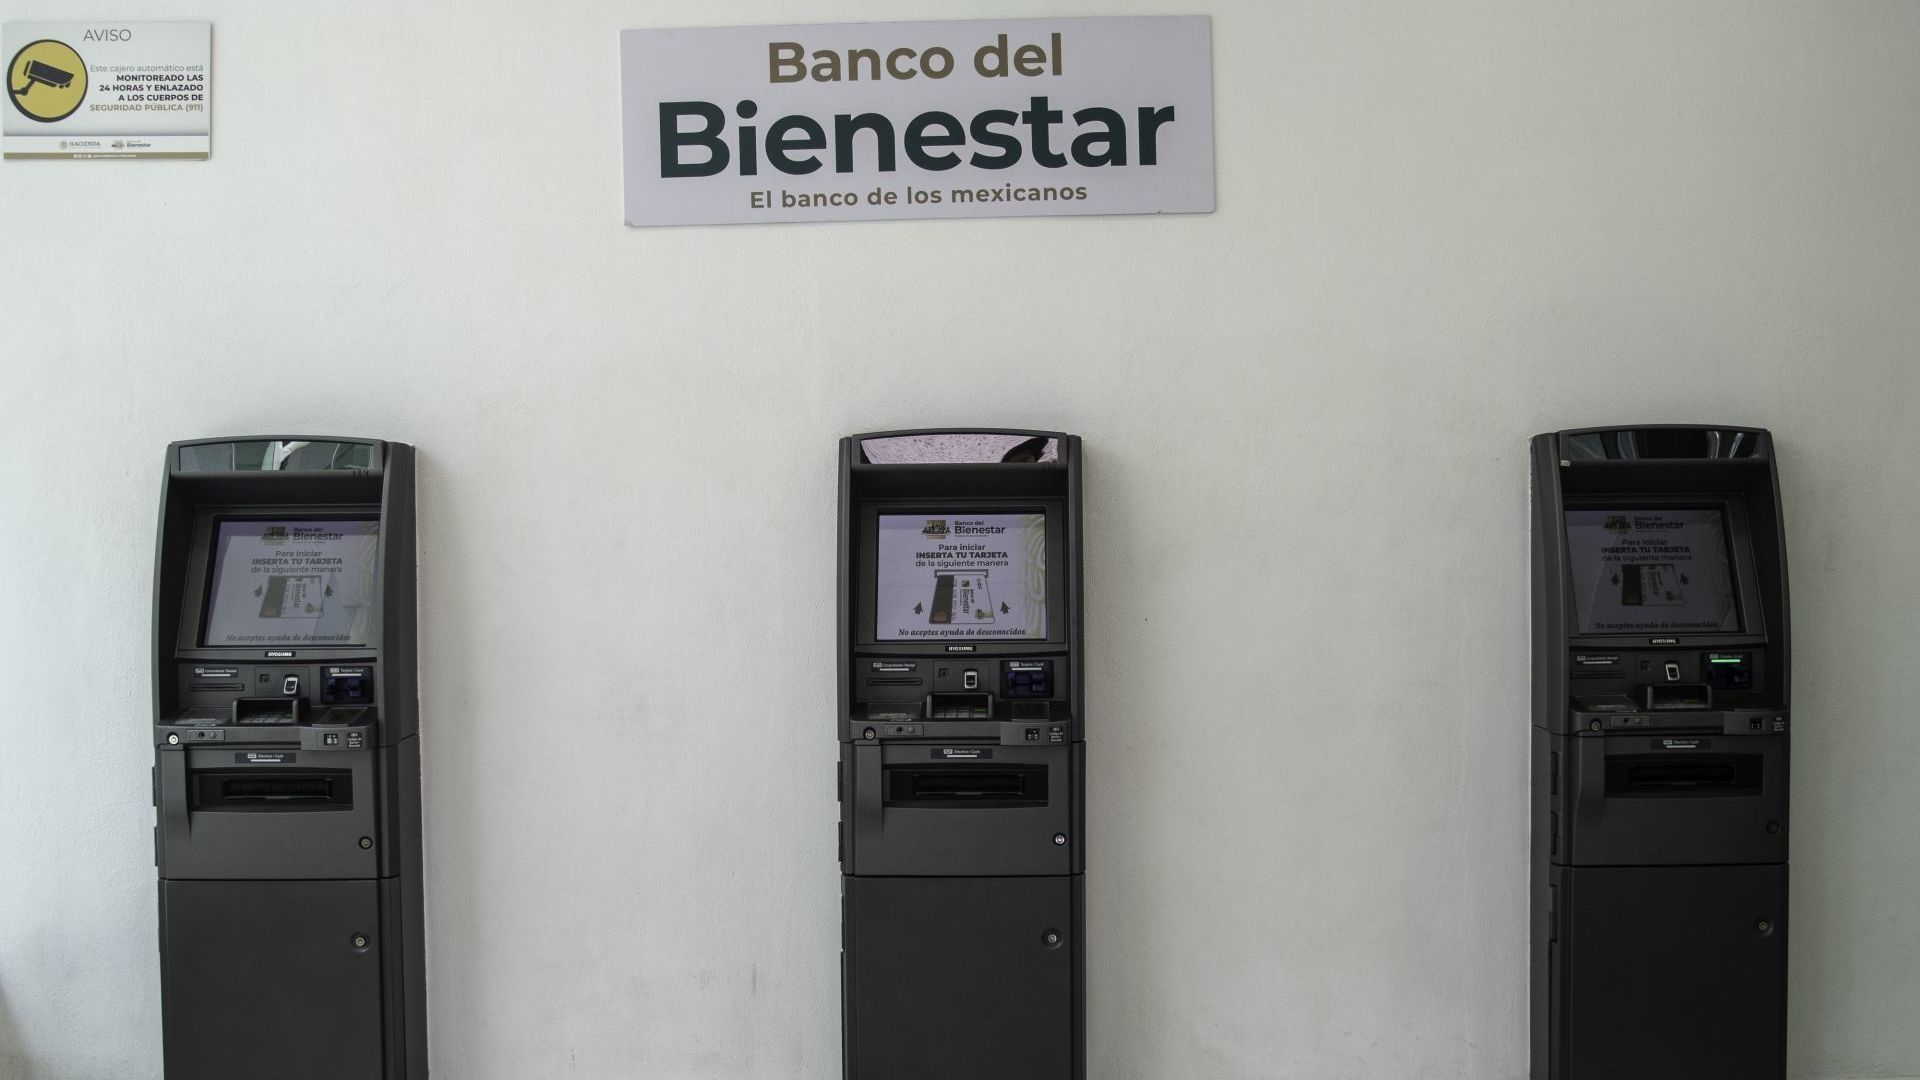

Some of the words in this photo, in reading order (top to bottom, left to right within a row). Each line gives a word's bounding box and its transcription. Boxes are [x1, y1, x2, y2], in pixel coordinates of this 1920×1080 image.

[83, 29, 132, 42] AVISO
[769, 41, 955, 83] Banco
[973, 33, 1063, 78] del
[90, 65, 108, 73] Este
[110, 65, 135, 74] cajero
[136, 64, 185, 73] automático
[186, 64, 204, 72] está
[116, 74, 185, 82] MONITOREADO
[186, 74, 204, 82] LAS
[99, 84, 110, 92] 24
[112, 84, 144, 92] HORAS
[146, 84, 153, 92] Y
[154, 84, 204, 92] ENLAZADO
[127, 94, 145, 102] LOS
[146, 94, 189, 102] CUERPOS
[89, 104, 142, 112] SEGURIDAD
[144, 103, 183, 112] PÚBLICA
[185, 103, 204, 112] (911)
[658, 96, 1176, 179] Bienestar
[750, 189, 772, 209] El
[781, 188, 859, 208] banco
[866, 187, 898, 206] de
[906, 185, 943, 205] los
[951, 182, 1088, 204] mexicanos
[954, 526, 1006, 534] Bienestar
[1635, 521, 1684, 530] Bienestar
[293, 532, 343, 541] Bienestar
[1622, 538, 1640, 546] Para
[959, 543, 986, 551] iniciar
[252, 558, 289, 566] INSERTA
[915, 559, 926, 567] de
[928, 559, 935, 567] la
[937, 559, 975, 568] siguiente
[250, 565, 261, 573] de
[263, 565, 270, 573] la
[272, 565, 310, 574] siguiente
[898, 628, 909, 636] No
[911, 629, 939, 637] aceptes
[940, 628, 964, 637] ayuda
[966, 628, 975, 636] de
[977, 628, 1026, 636] desconocidos
[267, 634, 291, 642] ayuda
